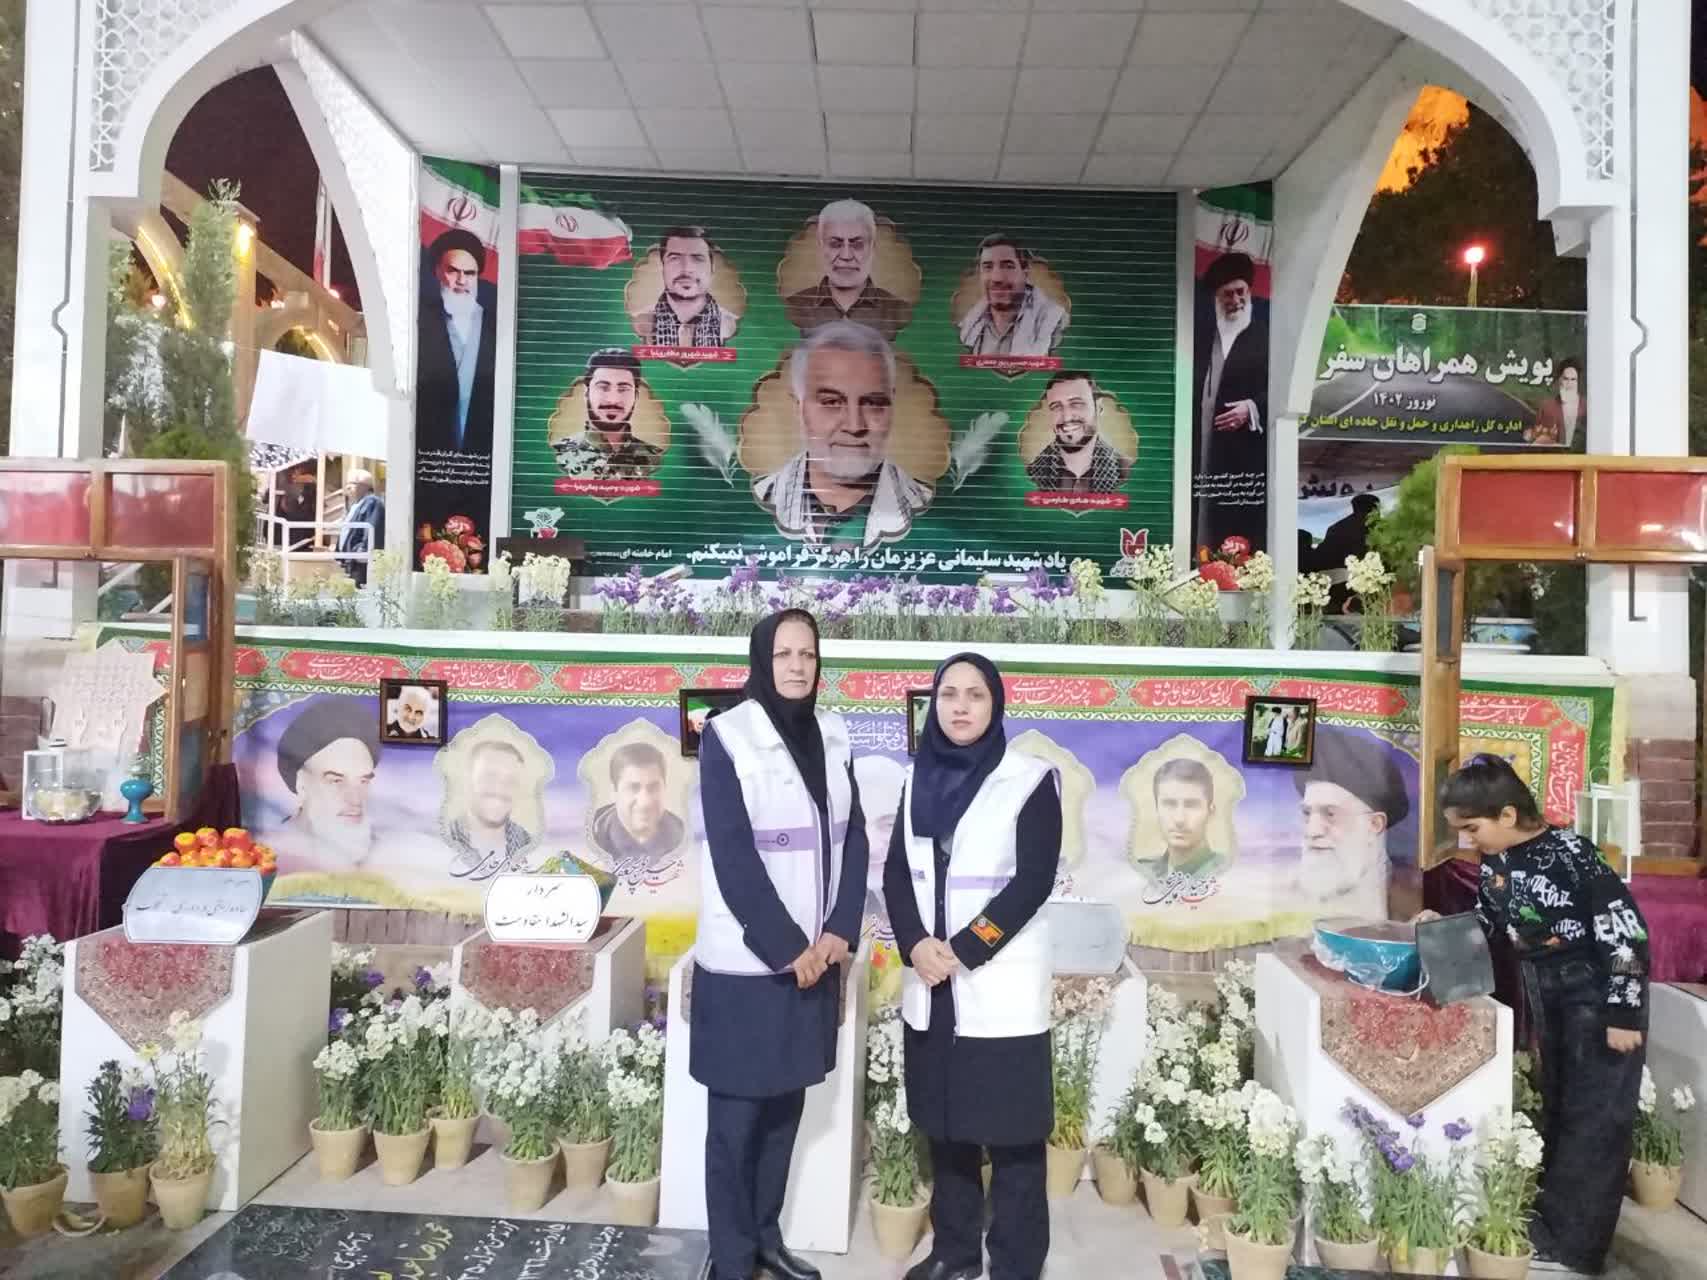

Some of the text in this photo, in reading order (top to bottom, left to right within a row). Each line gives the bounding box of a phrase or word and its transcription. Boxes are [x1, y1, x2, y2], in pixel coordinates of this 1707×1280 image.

[1319, 343, 1553, 387] پویش همراهان سفر
[1373, 391, 1437, 412] نوروز ۱۴۰۲
[1340, 415, 1354, 430] ای
[1355, 415, 1378, 428] جاده
[1380, 416, 1398, 431] نقل
[1399, 421, 1406, 431] و
[1408, 417, 1431, 432] حمل
[1432, 422, 1438, 433] و
[1442, 417, 1480, 434] راهداری
[1481, 419, 1496, 434] کل
[1497, 420, 1523, 434] اداره
[631, 549, 655, 559] خامنه
[655, 549, 673, 561] امام
[854, 548, 871, 570] را
[871, 546, 936, 571] عزیزمان
[939, 548, 1001, 571] سلیمانی
[1003, 551, 1043, 572] شهید
[1044, 551, 1067, 573] یاد
